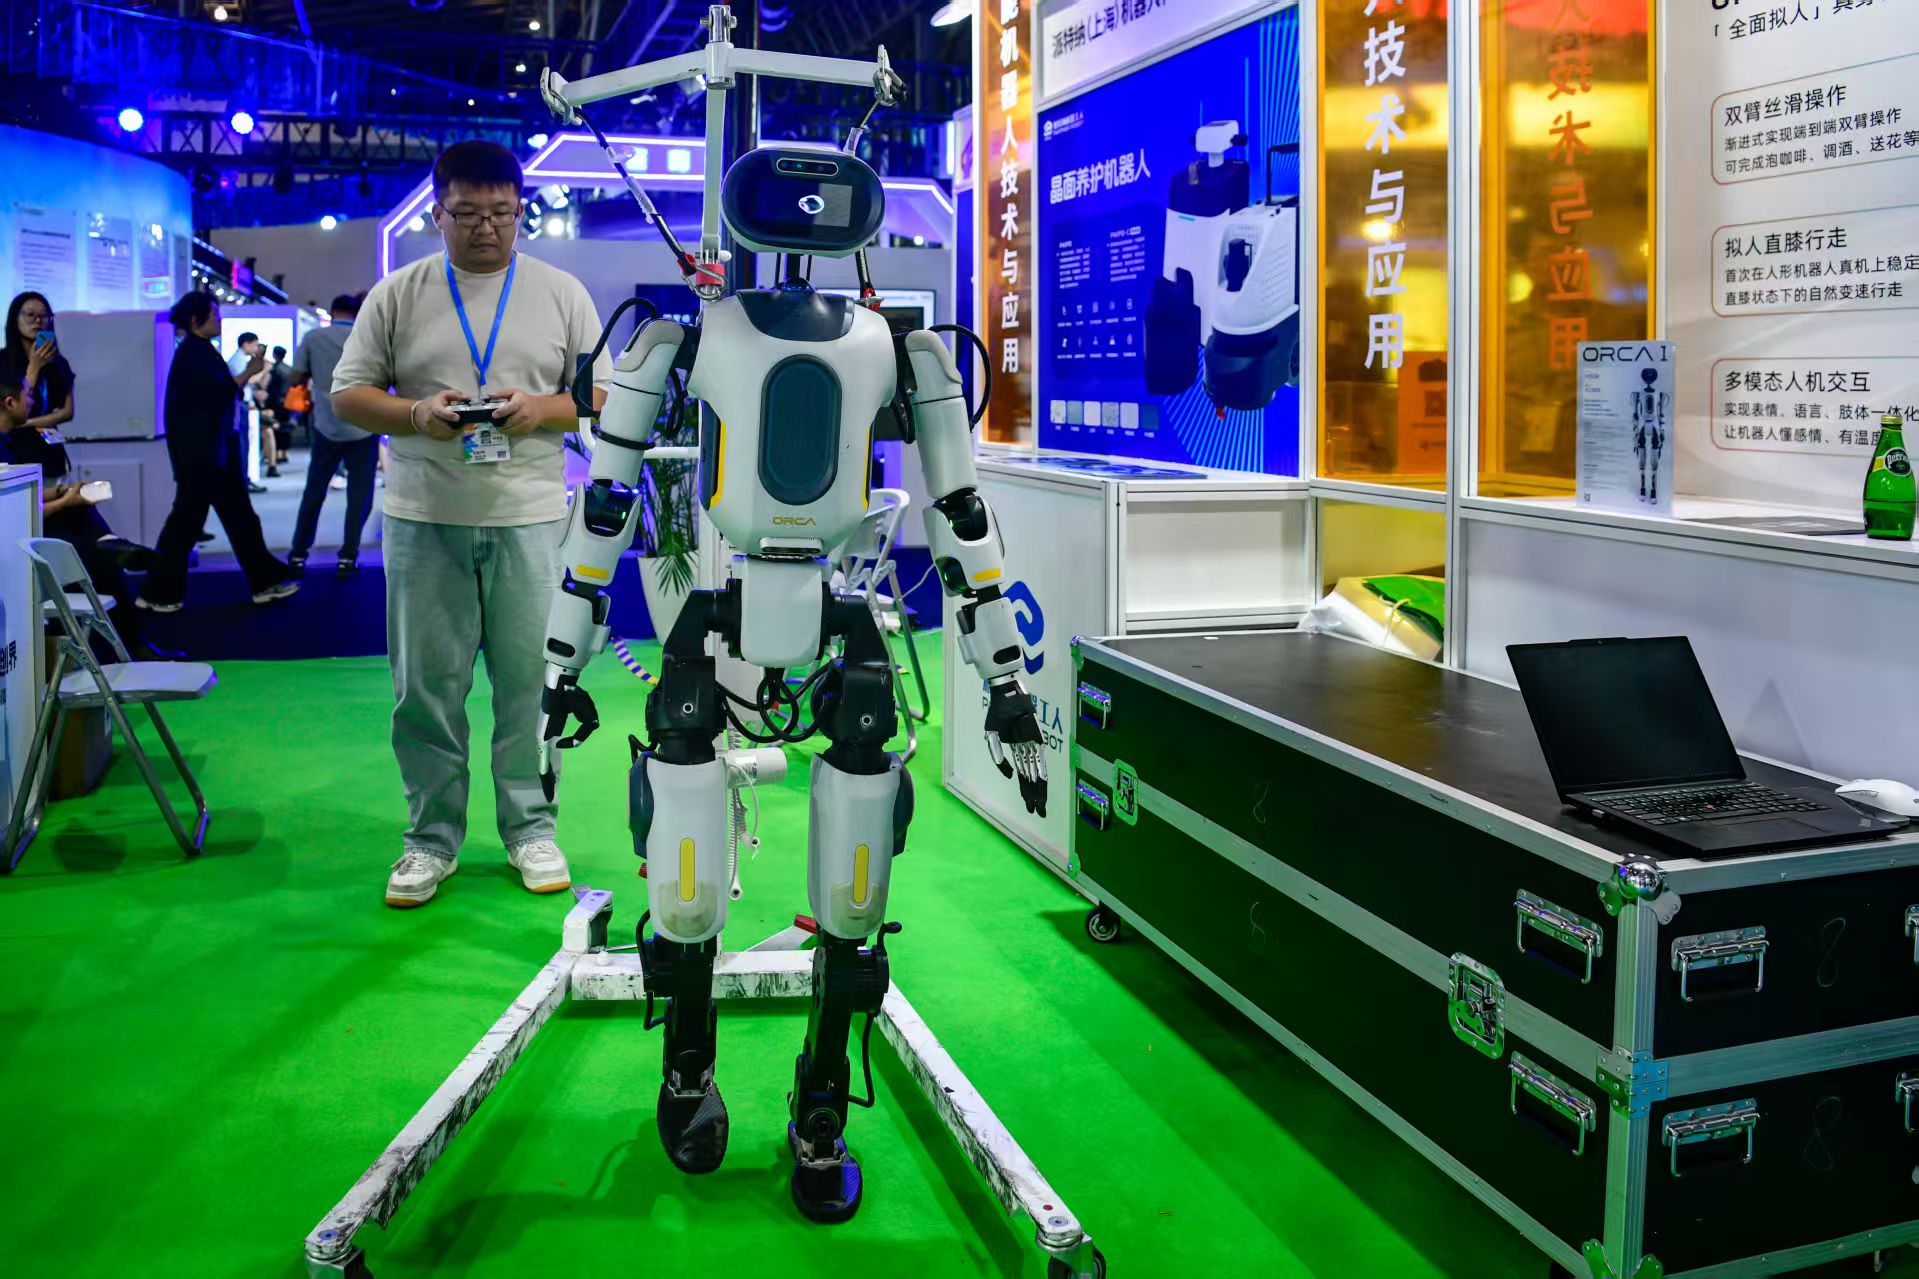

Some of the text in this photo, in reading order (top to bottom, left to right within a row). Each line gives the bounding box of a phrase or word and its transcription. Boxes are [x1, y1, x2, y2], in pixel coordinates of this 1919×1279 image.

[1724, 84, 1847, 127] 双臂丝滑操作
[1724, 108, 1902, 152] 渐进式实现端到端双臂操作
[1725, 227, 1847, 258] 拟人直膝行走
[1725, 254, 1919, 283] 首次在人形机器人真机上稳定
[1725, 281, 1903, 306] 直膝状态下的自然变速行走
[1583, 346, 1653, 362] ORCA
[1725, 372, 1871, 393] 多模态人机交互
[773, 516, 816, 526] ORCA
